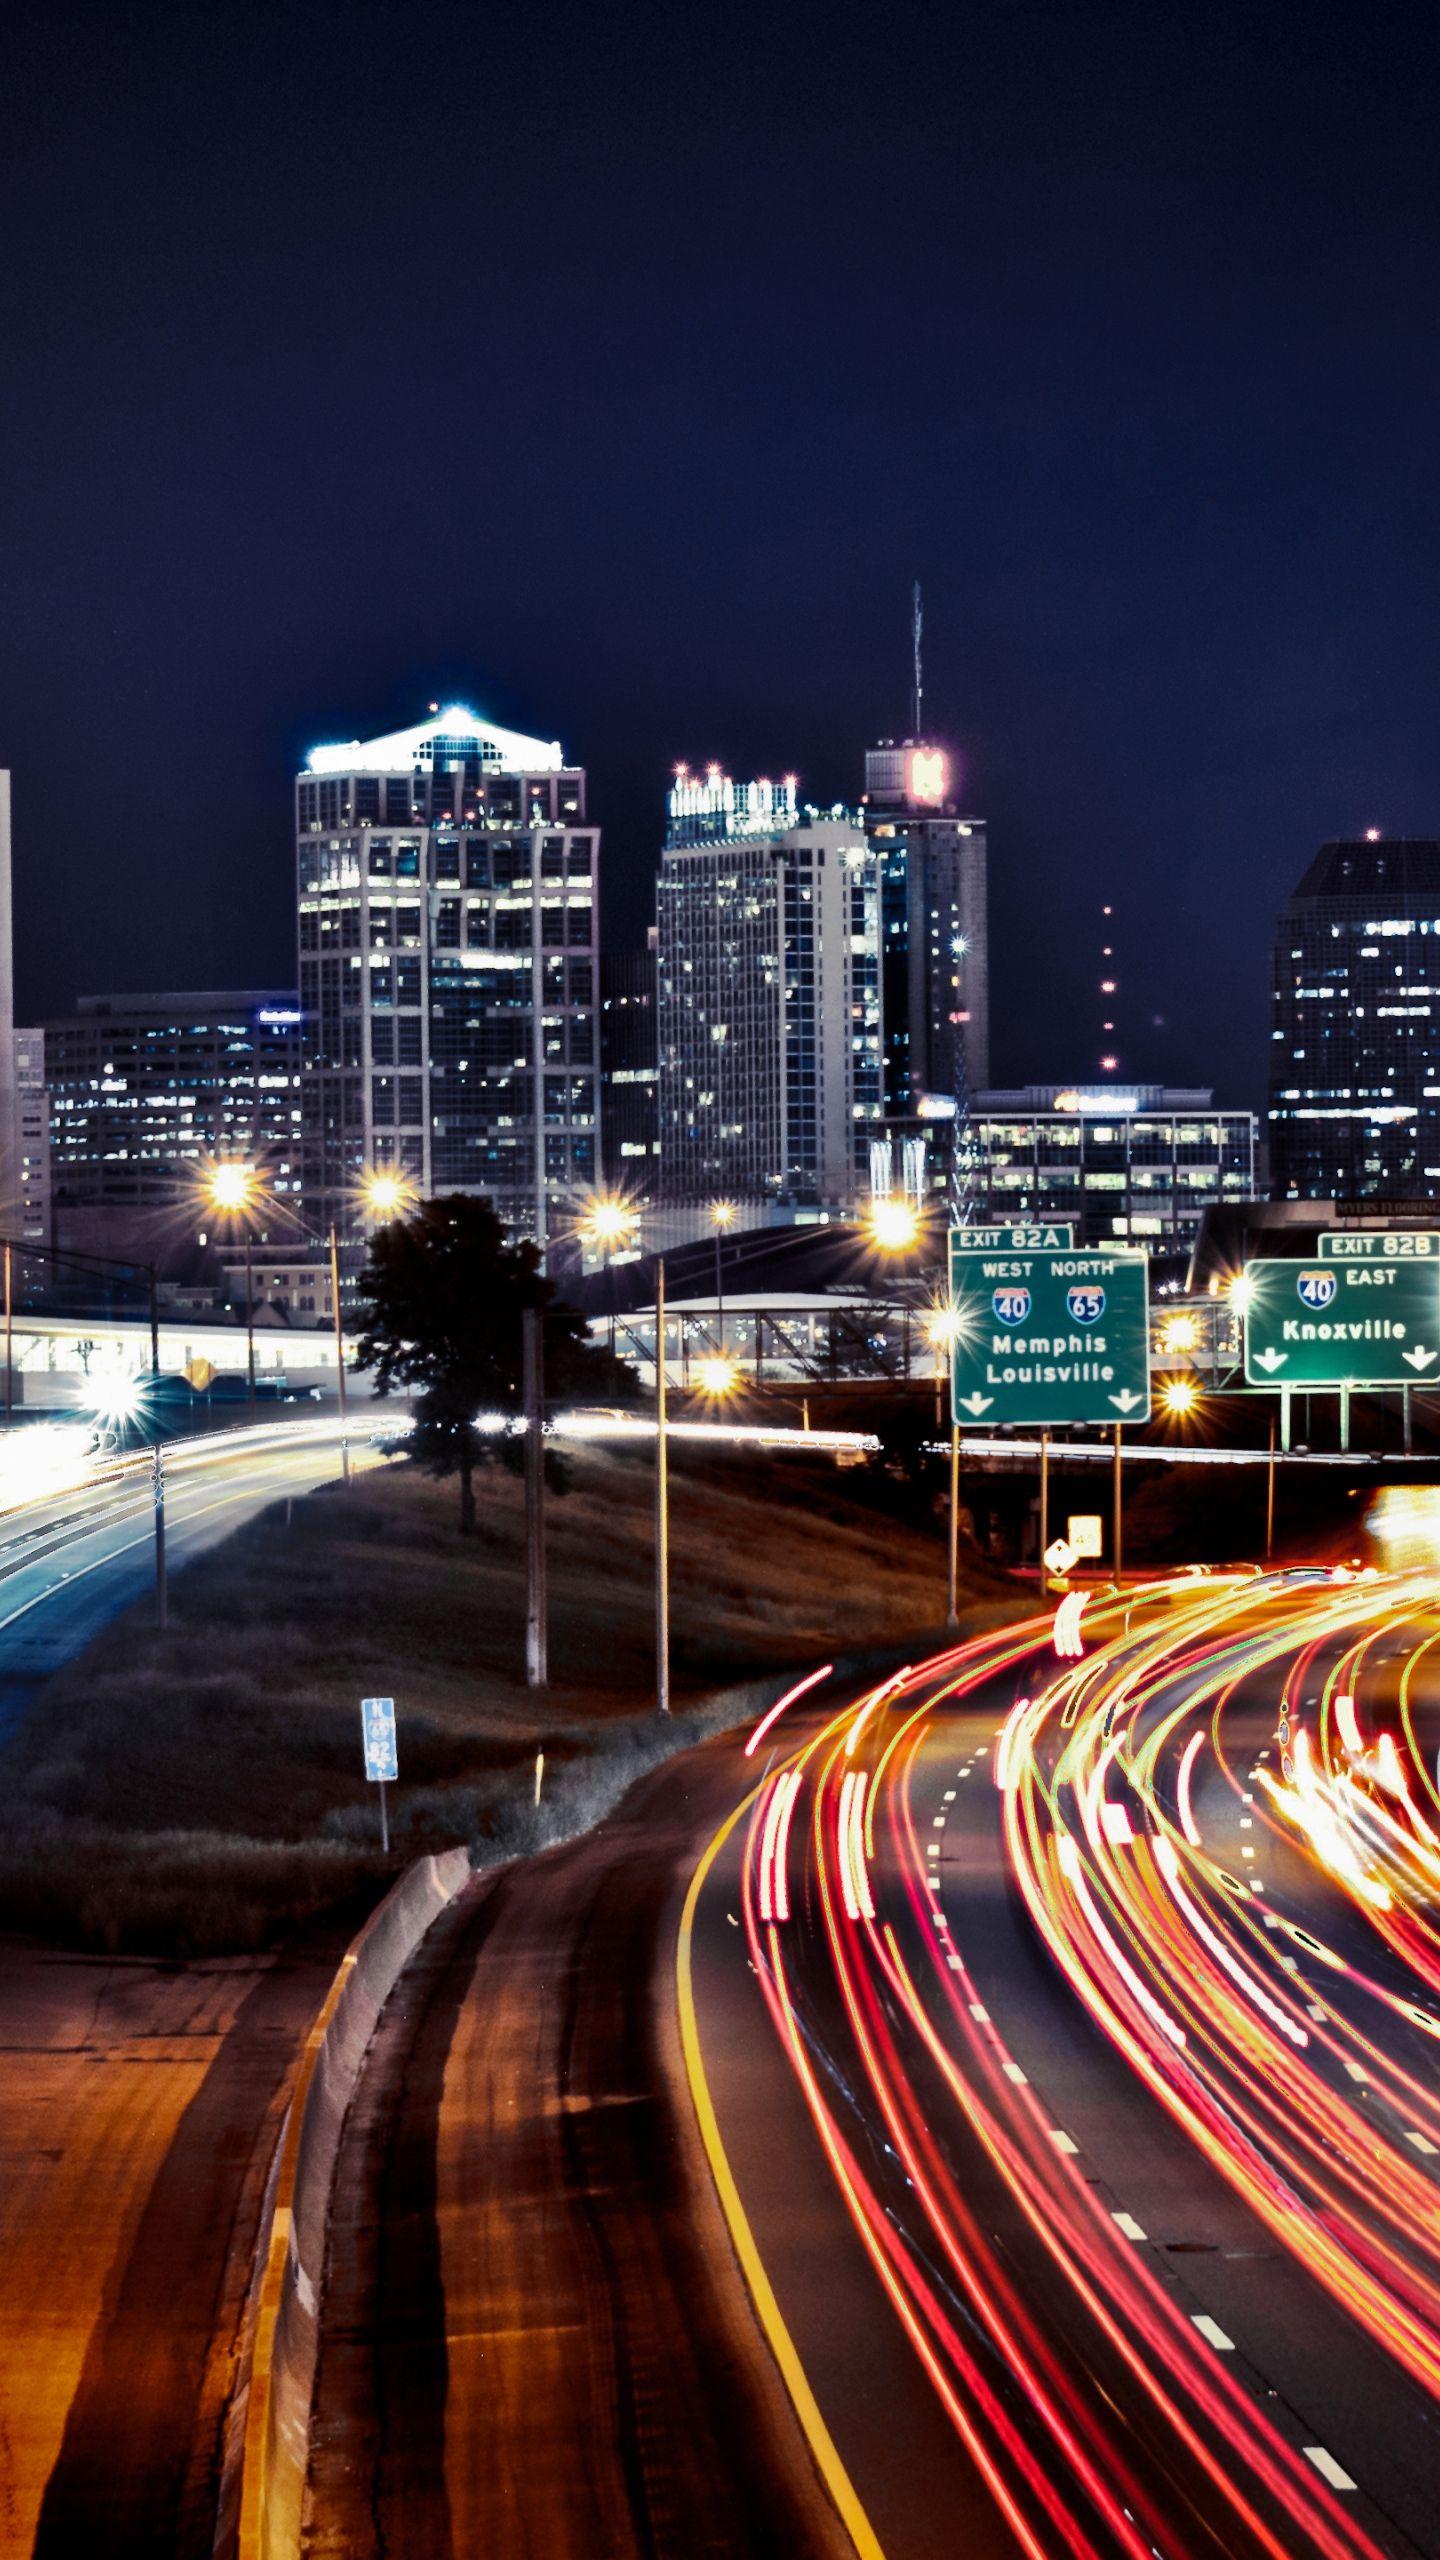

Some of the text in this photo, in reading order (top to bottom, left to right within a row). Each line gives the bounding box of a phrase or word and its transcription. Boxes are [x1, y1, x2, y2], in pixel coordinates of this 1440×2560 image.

[1337, 1201, 1378, 1214] MYERS
[959, 1229, 1060, 1248] EXIT 82A
[1331, 1236, 1431, 1256] EXIT 82B
[982, 1260, 1115, 1278] WEST NORTH
[1346, 1269, 1397, 1286] EAST
[1303, 1280, 1331, 1302] 40
[998, 1296, 1027, 1318] 40
[1072, 1295, 1100, 1317] 65
[1282, 1319, 1407, 1341] Knoxville
[992, 1333, 1107, 1357] Memphis
[986, 1362, 1115, 1384] Louisville
